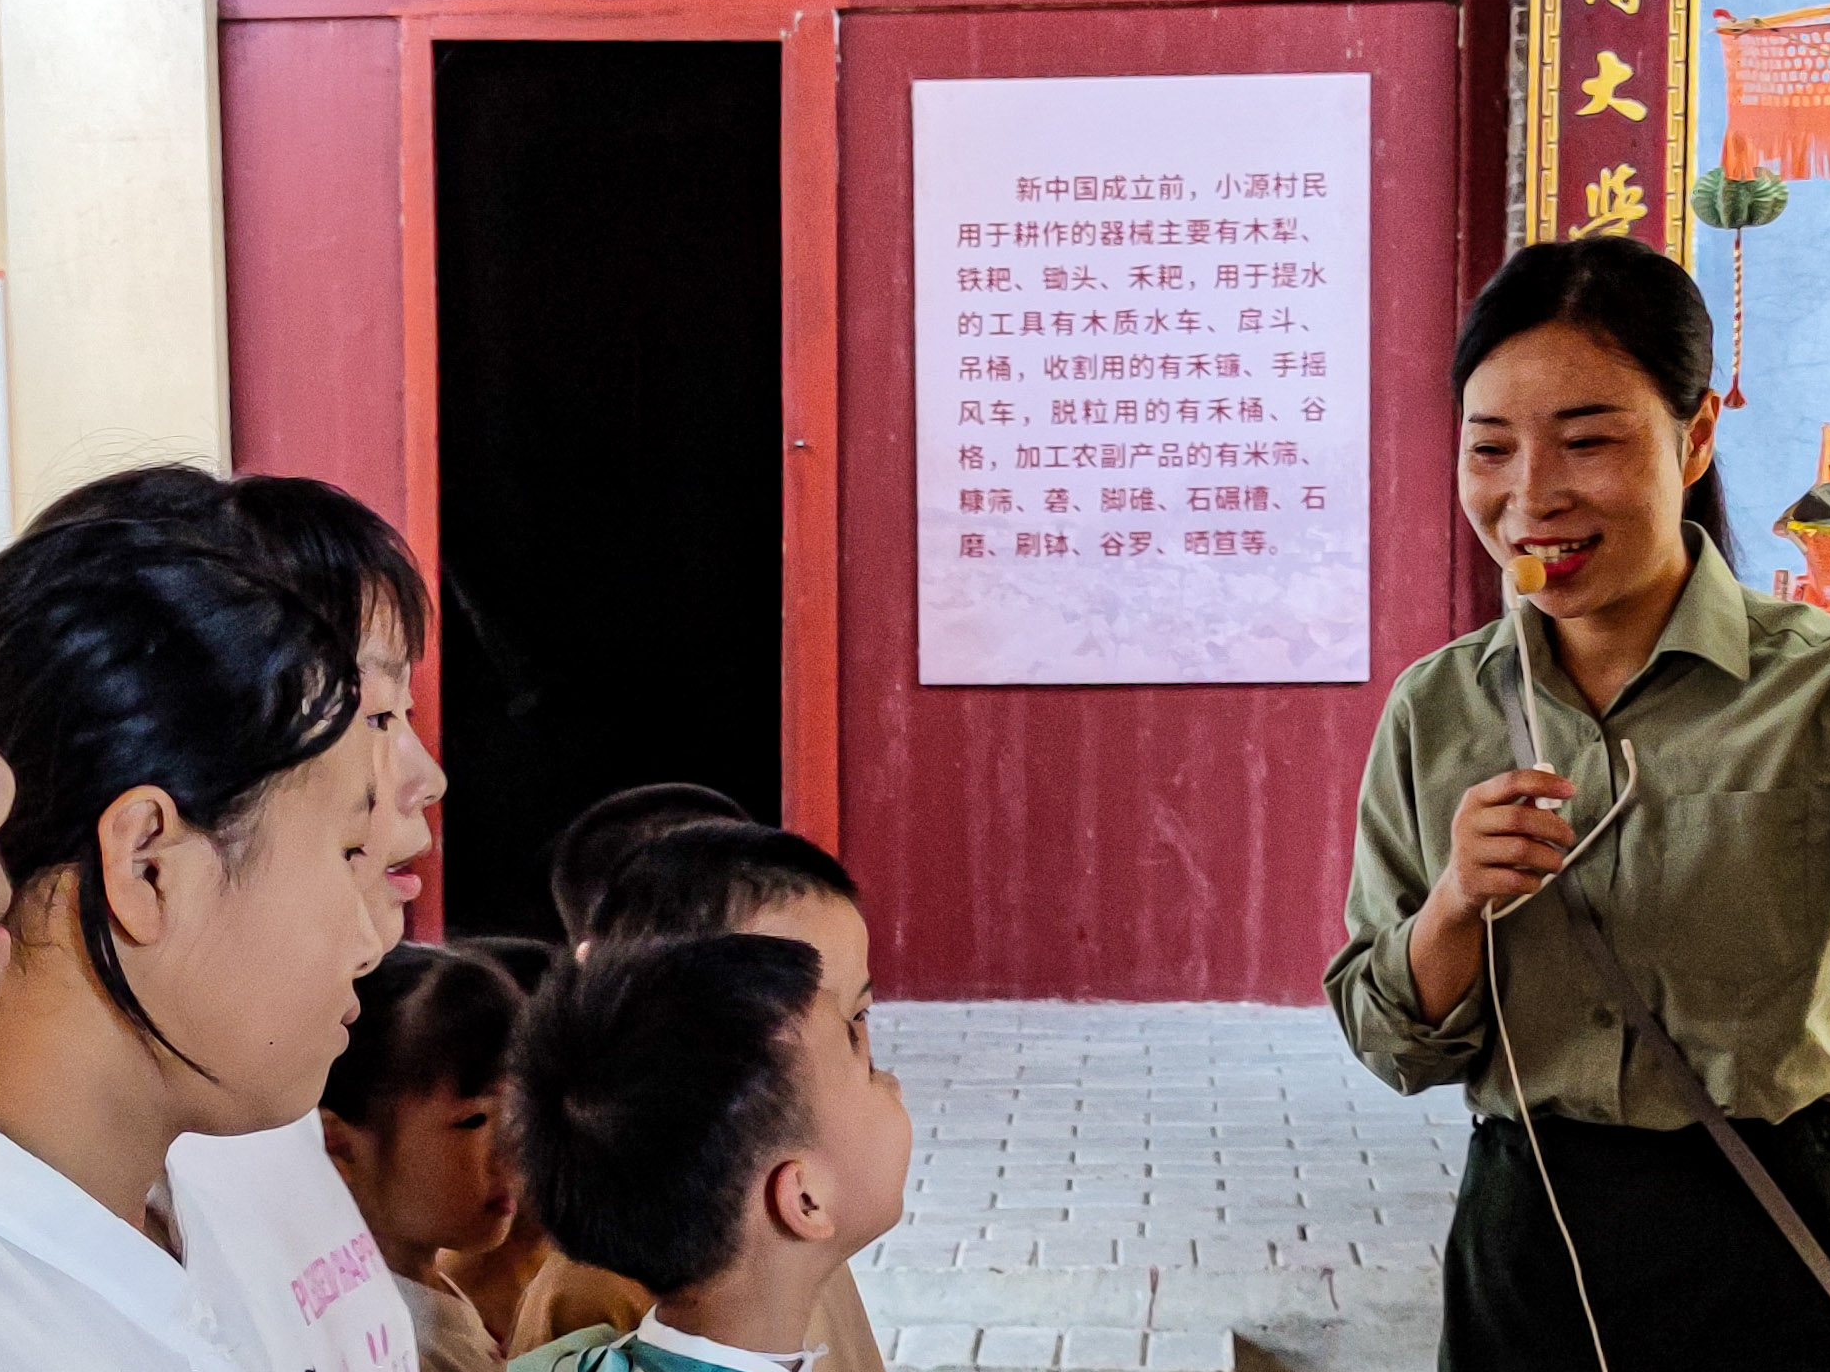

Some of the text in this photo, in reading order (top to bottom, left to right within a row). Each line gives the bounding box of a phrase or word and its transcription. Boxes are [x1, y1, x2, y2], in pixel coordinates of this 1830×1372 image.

[1016, 173, 1327, 202] 新中国成立前，小源村民
